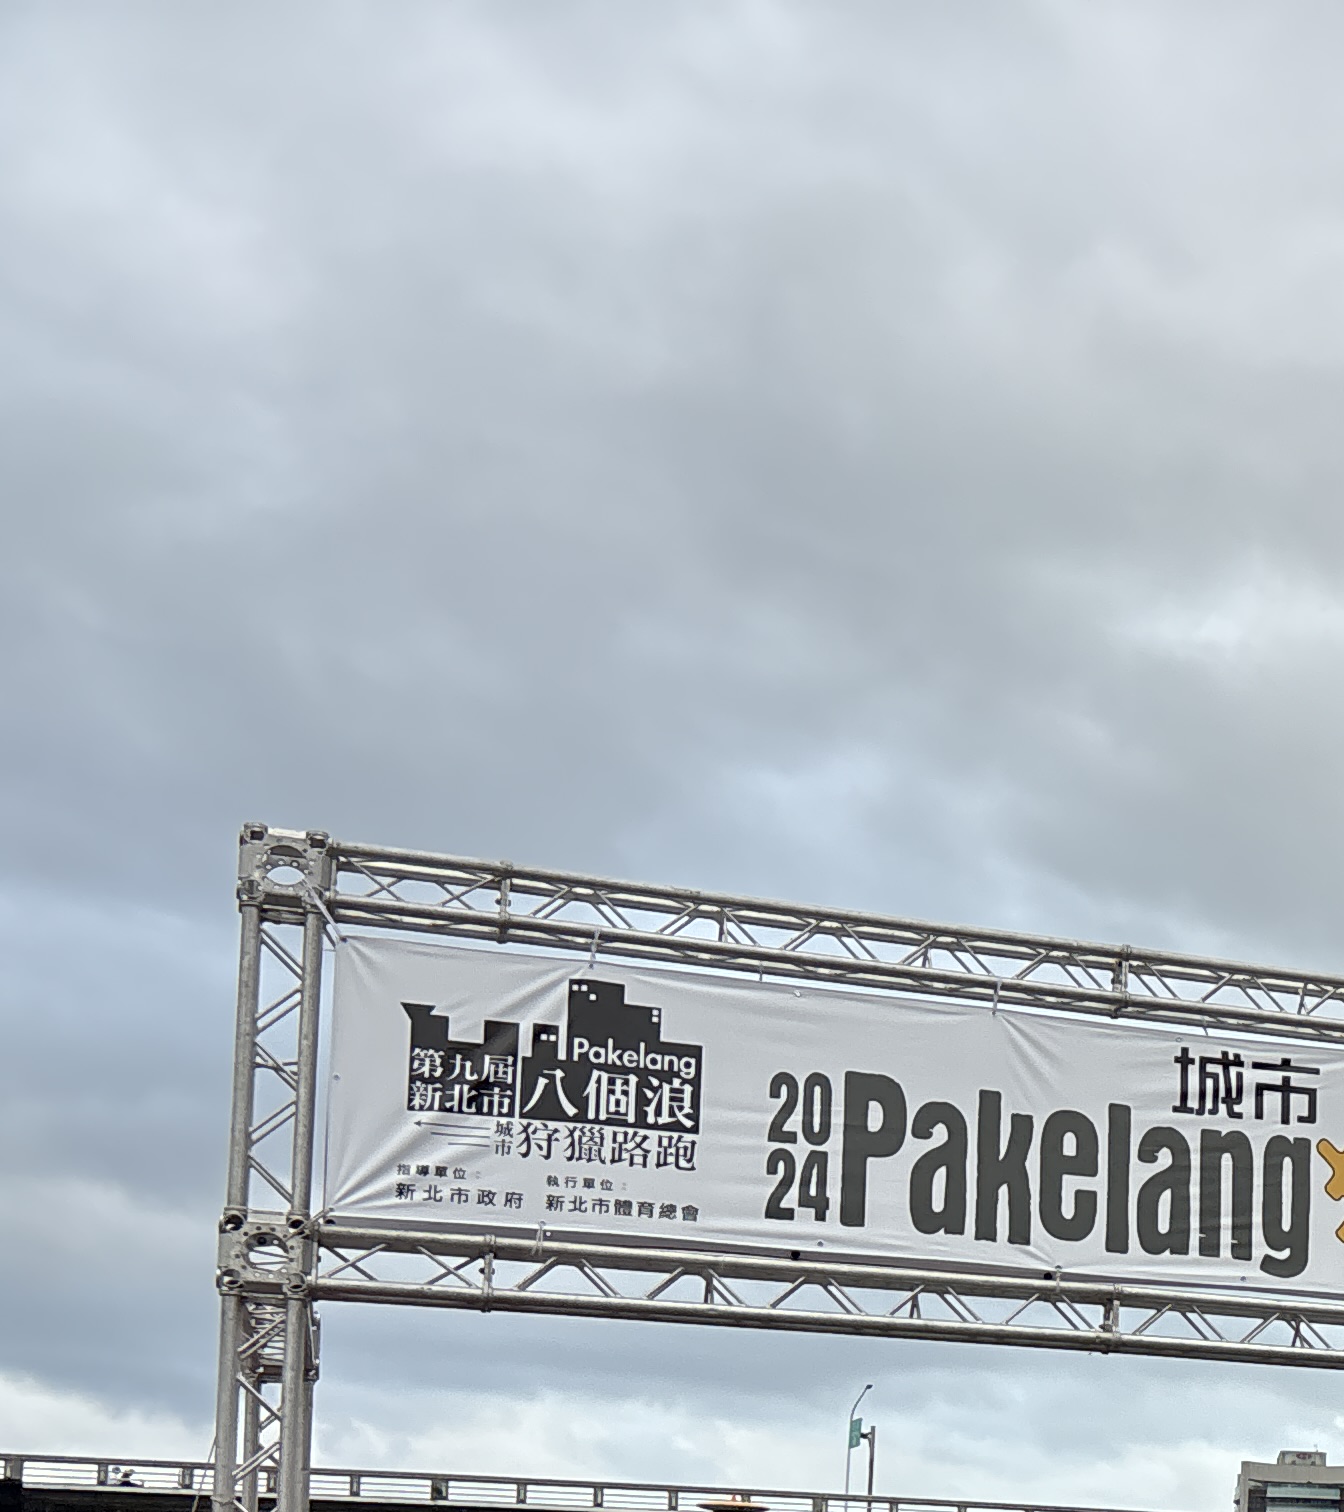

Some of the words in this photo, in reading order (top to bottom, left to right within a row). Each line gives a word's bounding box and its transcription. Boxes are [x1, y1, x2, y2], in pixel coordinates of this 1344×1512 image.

[410, 1047, 515, 1085] 第九屆
[573, 1037, 697, 1079] Pakelang
[409, 1080, 514, 1116] 新北市
[521, 1068, 697, 1129] 八個浪
[769, 1071, 832, 1146] 20
[1172, 1046, 1321, 1125] 城市
[494, 1121, 514, 1157] 城市
[516, 1121, 698, 1171] 狩獵路跑
[395, 1182, 525, 1210] 新北市政府
[765, 1148, 830, 1222] 24
[839, 1069, 1312, 1279] Pakelang
[545, 1194, 700, 1222] 新北市體育總會
